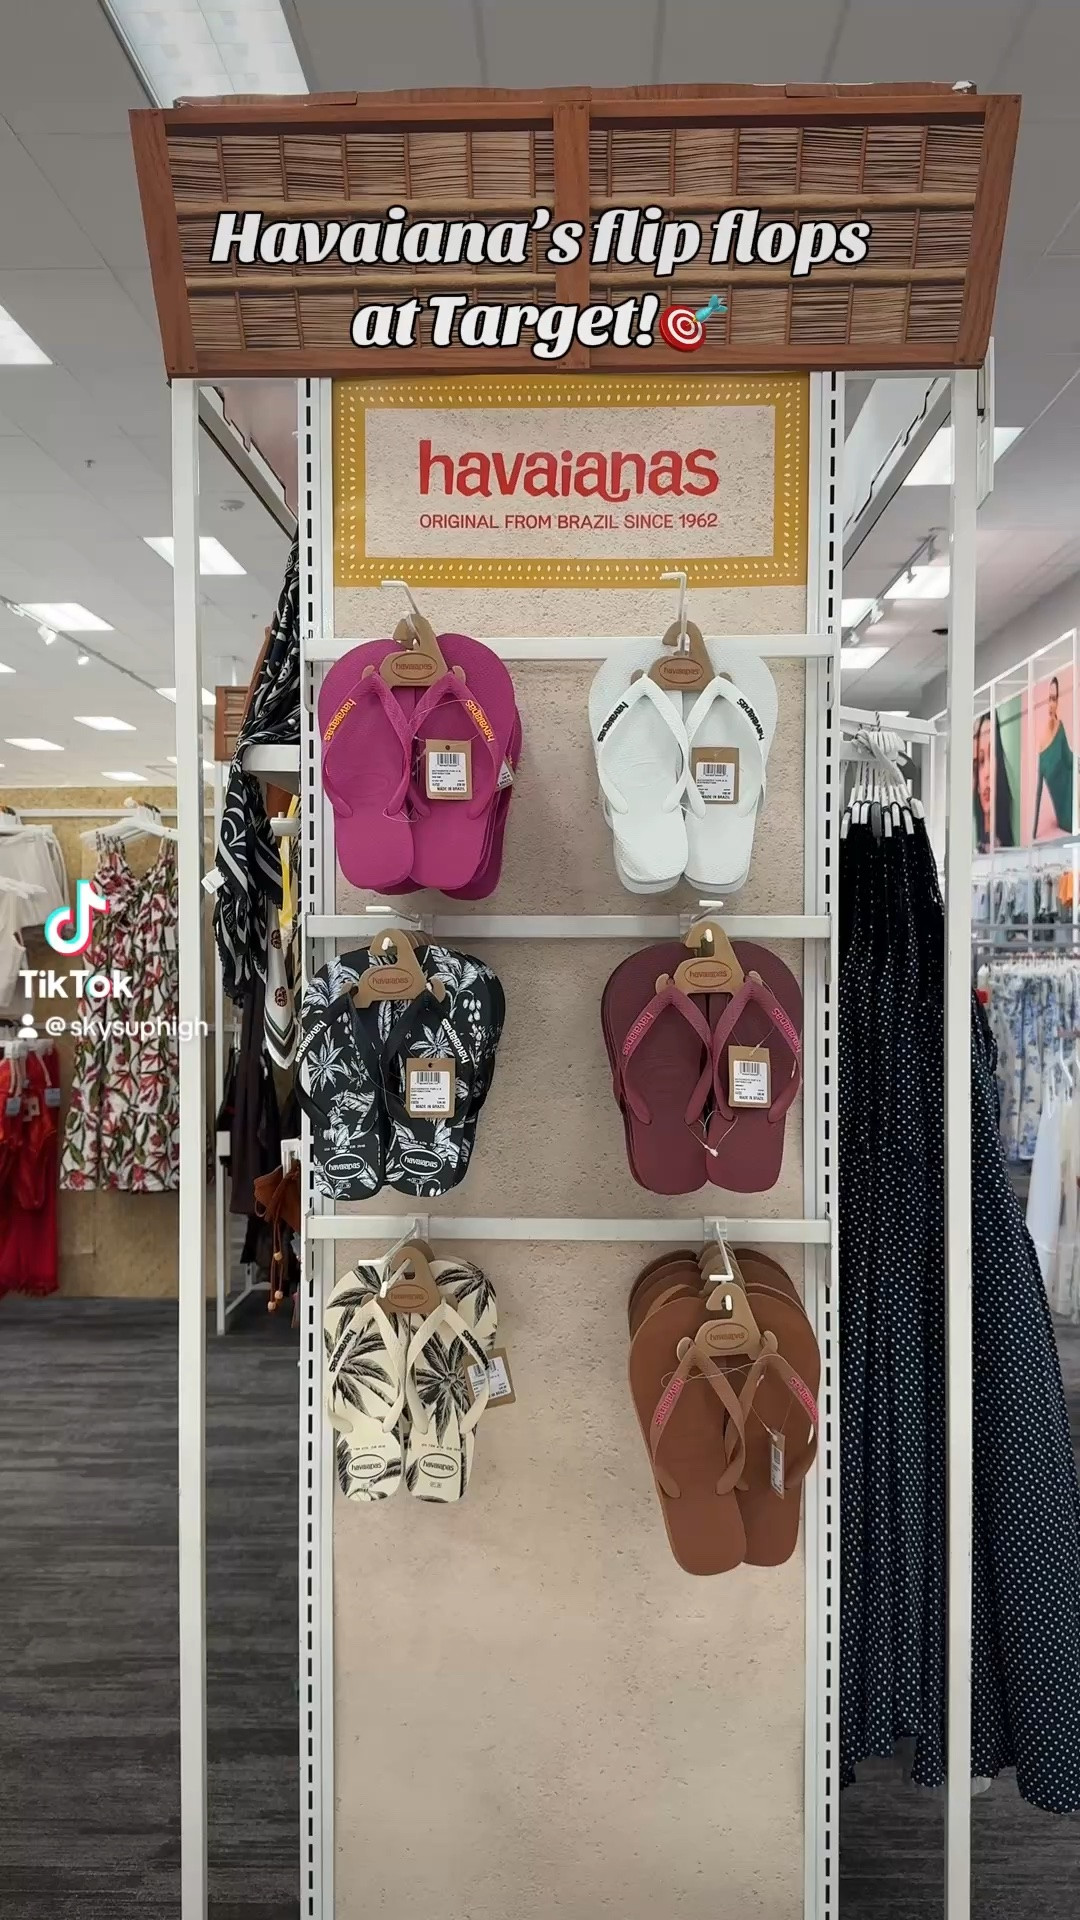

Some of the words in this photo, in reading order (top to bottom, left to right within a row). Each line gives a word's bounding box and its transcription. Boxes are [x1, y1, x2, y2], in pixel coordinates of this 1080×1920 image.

[419, 439, 720, 503] havaianas
[419, 513, 499, 529] ORIGINAL
[504, 513, 552, 529] FROM
[557, 513, 619, 529] BRAZIL
[623, 513, 674, 529] SINCE
[678, 512, 719, 528] 1962
[324, 698, 357, 741] havaianas
[465, 699, 495, 743] havaianas
[597, 701, 629, 742] havaianas
[736, 698, 765, 741] havaianas
[294, 1020, 328, 1063] havaianas
[441, 1018, 470, 1065] havaianas
[623, 1012, 654, 1056] havaianas
[328, 1162, 361, 1171] havaianas
[404, 1155, 438, 1168] havaianas
[351, 1463, 382, 1471] havaianas
[423, 1460, 454, 1471] havaianas
